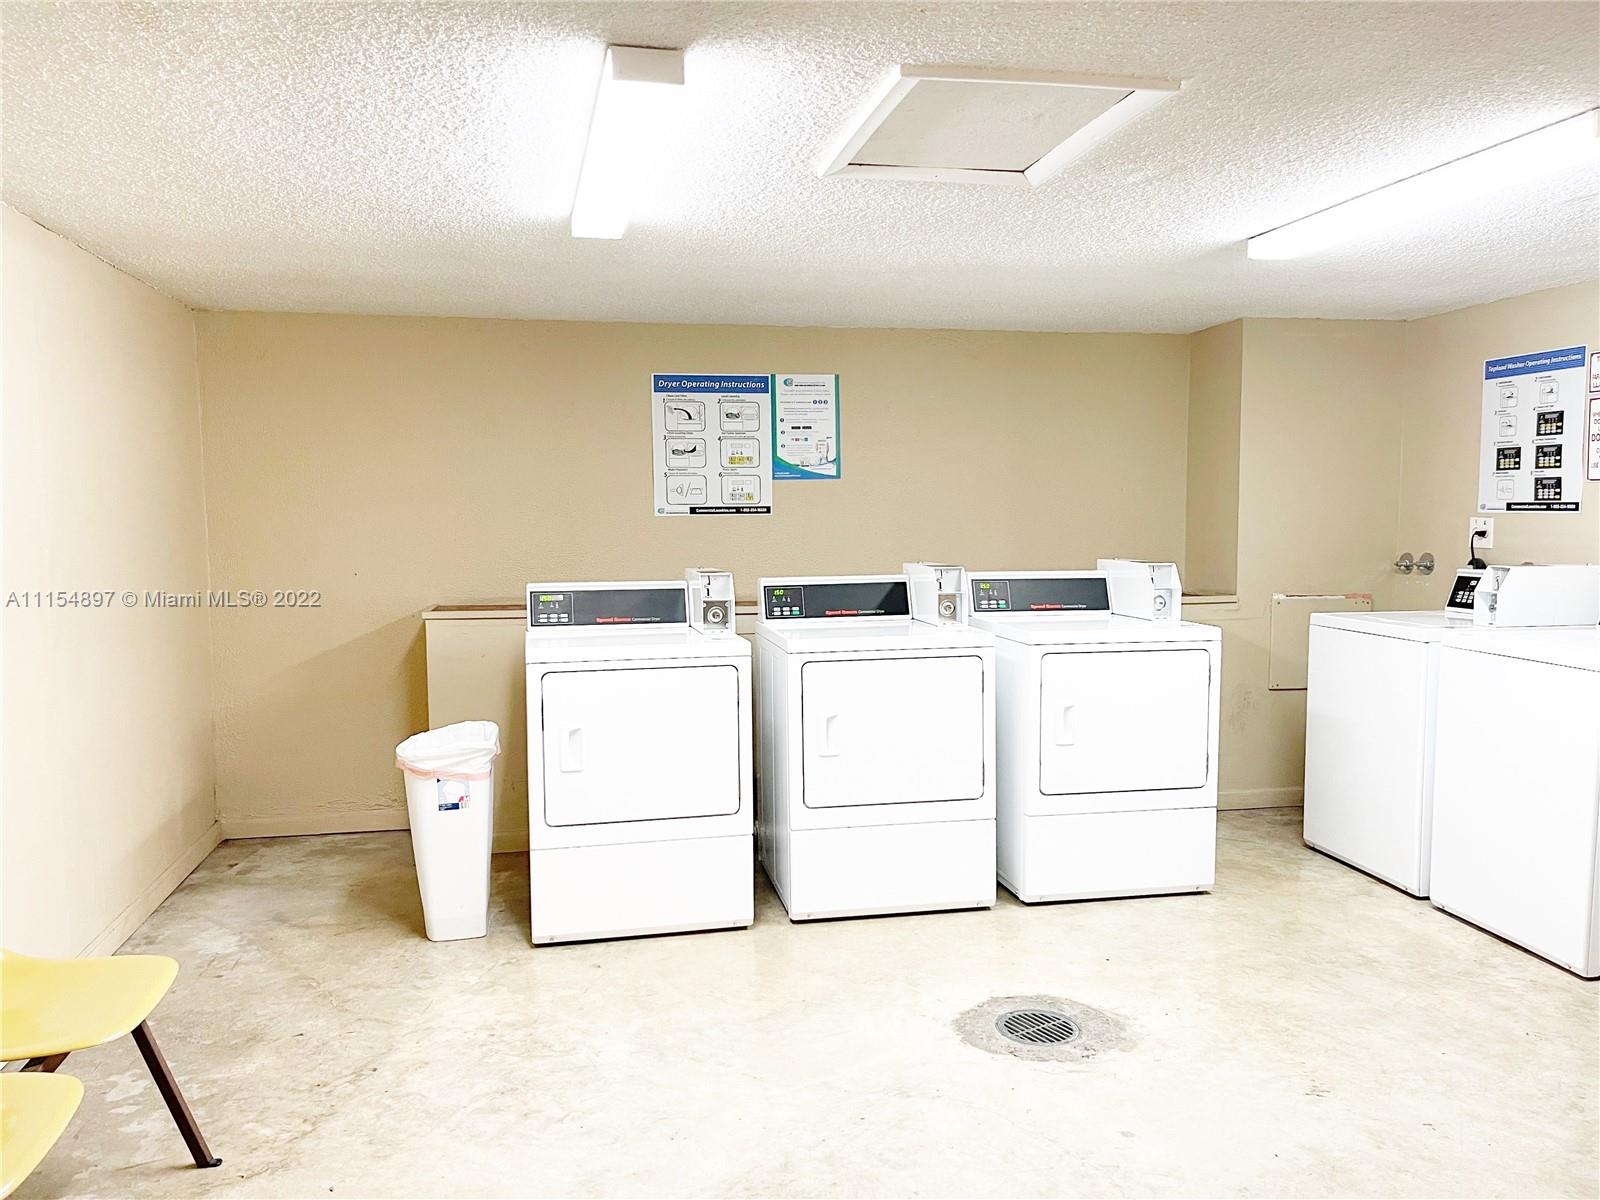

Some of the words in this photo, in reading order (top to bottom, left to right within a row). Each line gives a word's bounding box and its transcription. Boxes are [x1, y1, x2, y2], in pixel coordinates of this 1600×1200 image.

[1526, 358, 1550, 367] Operating
[1551, 354, 1582, 363] Instructions
[658, 380, 680, 389] Dryer
[681, 380, 720, 389] Operating
